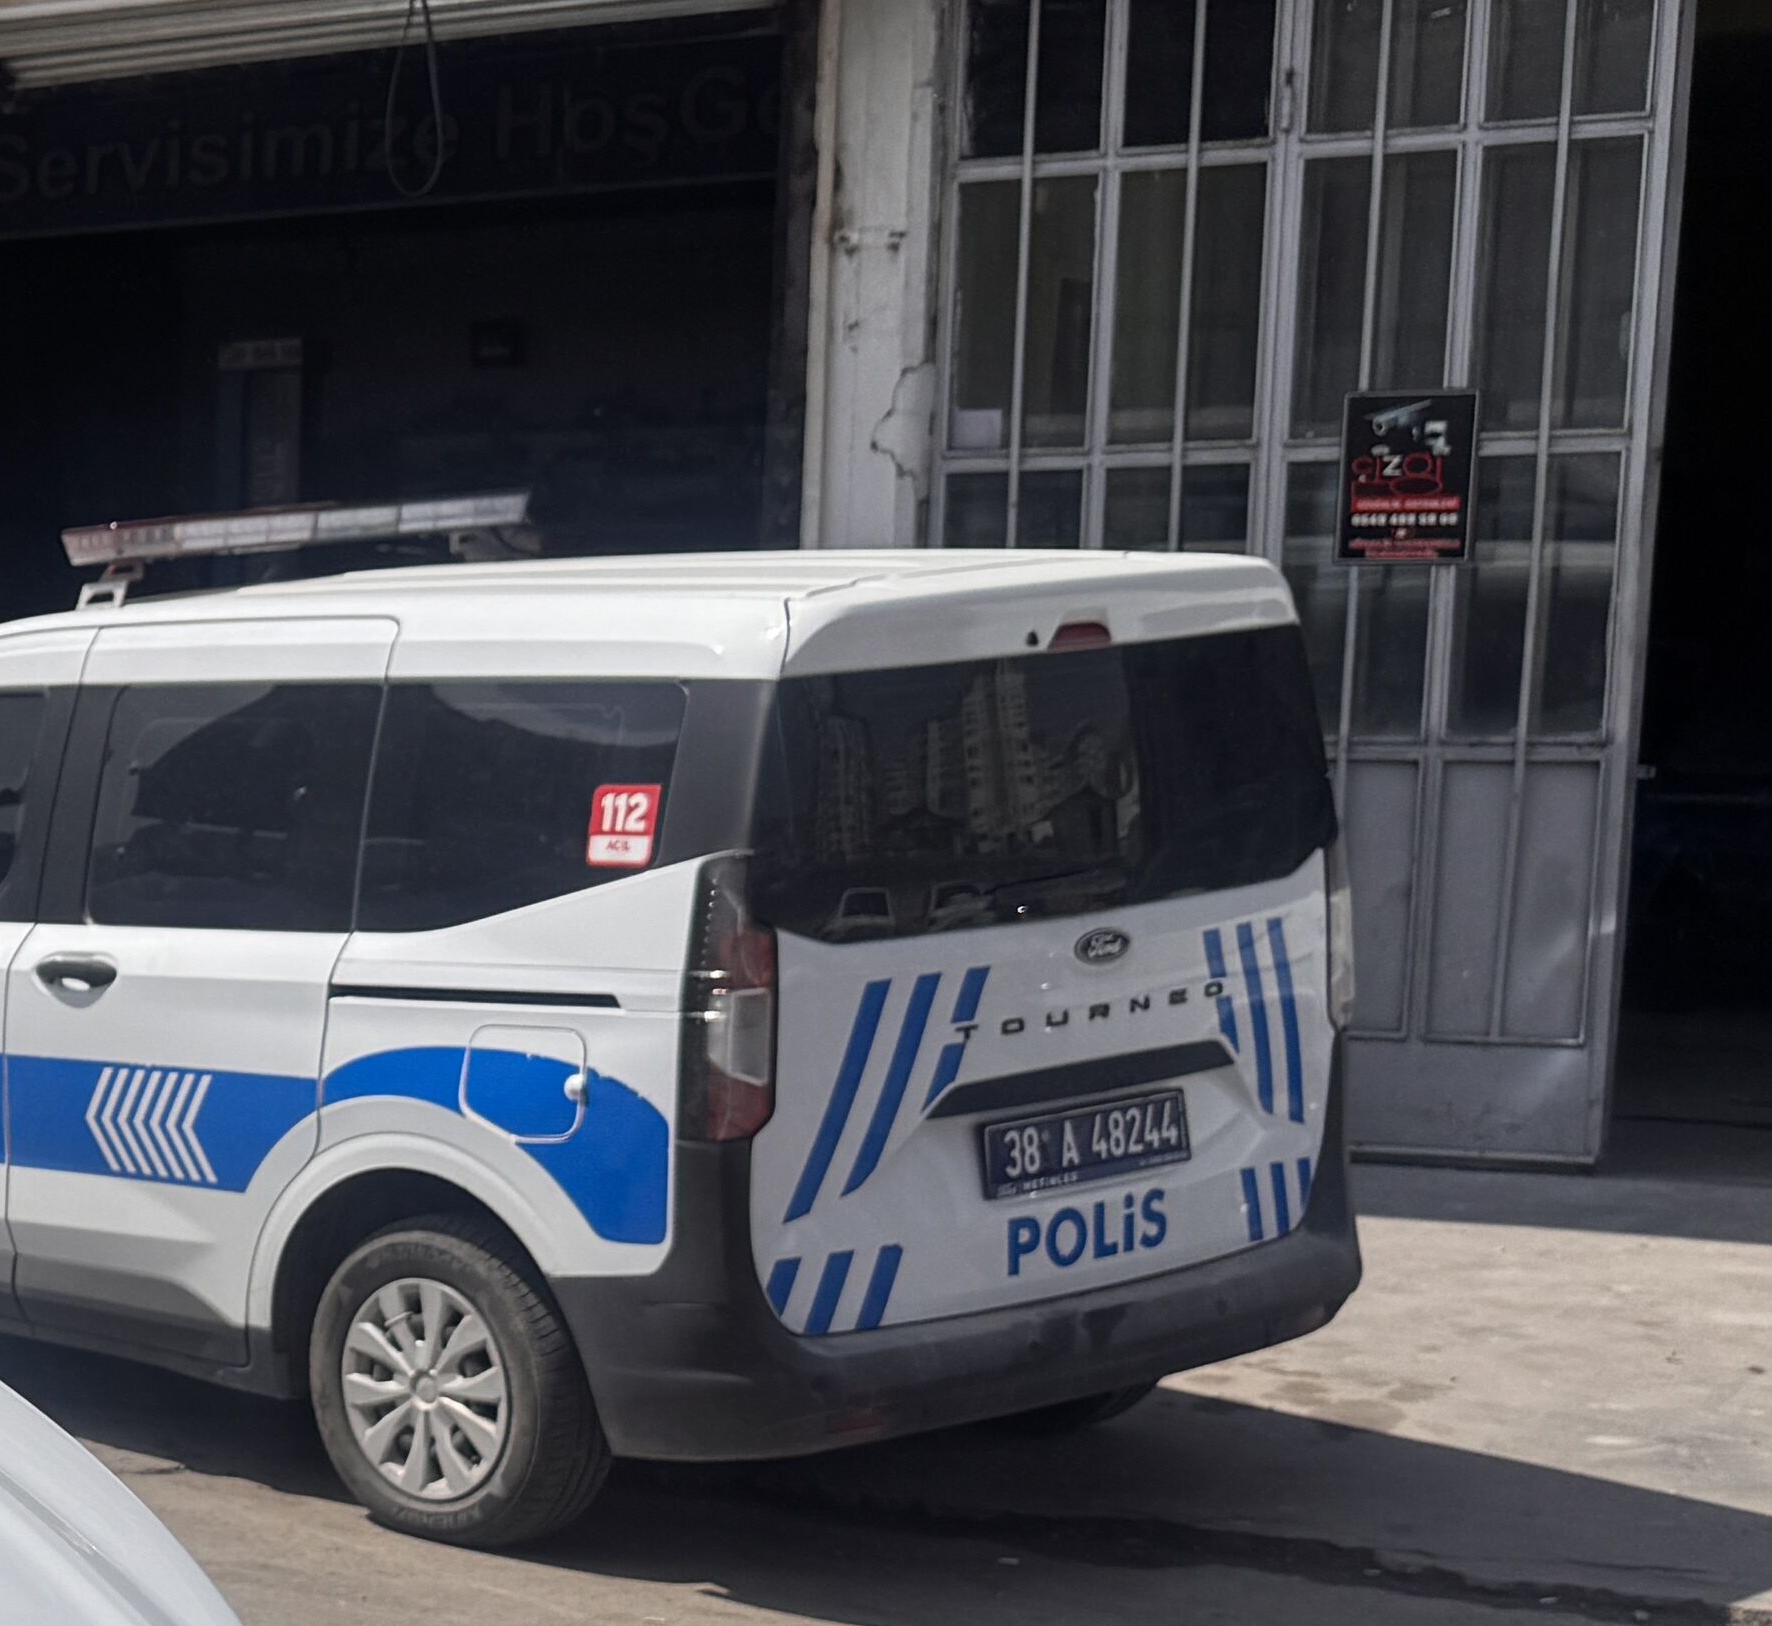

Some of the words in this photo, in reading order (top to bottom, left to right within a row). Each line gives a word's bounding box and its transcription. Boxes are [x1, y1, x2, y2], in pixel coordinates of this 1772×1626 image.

[600, 791, 650, 832] 112
[955, 980, 1224, 1041] TOURNEO
[1003, 1126, 1042, 1179] 38
[1061, 1119, 1081, 1168] A
[1091, 1100, 1179, 1160] 48244
